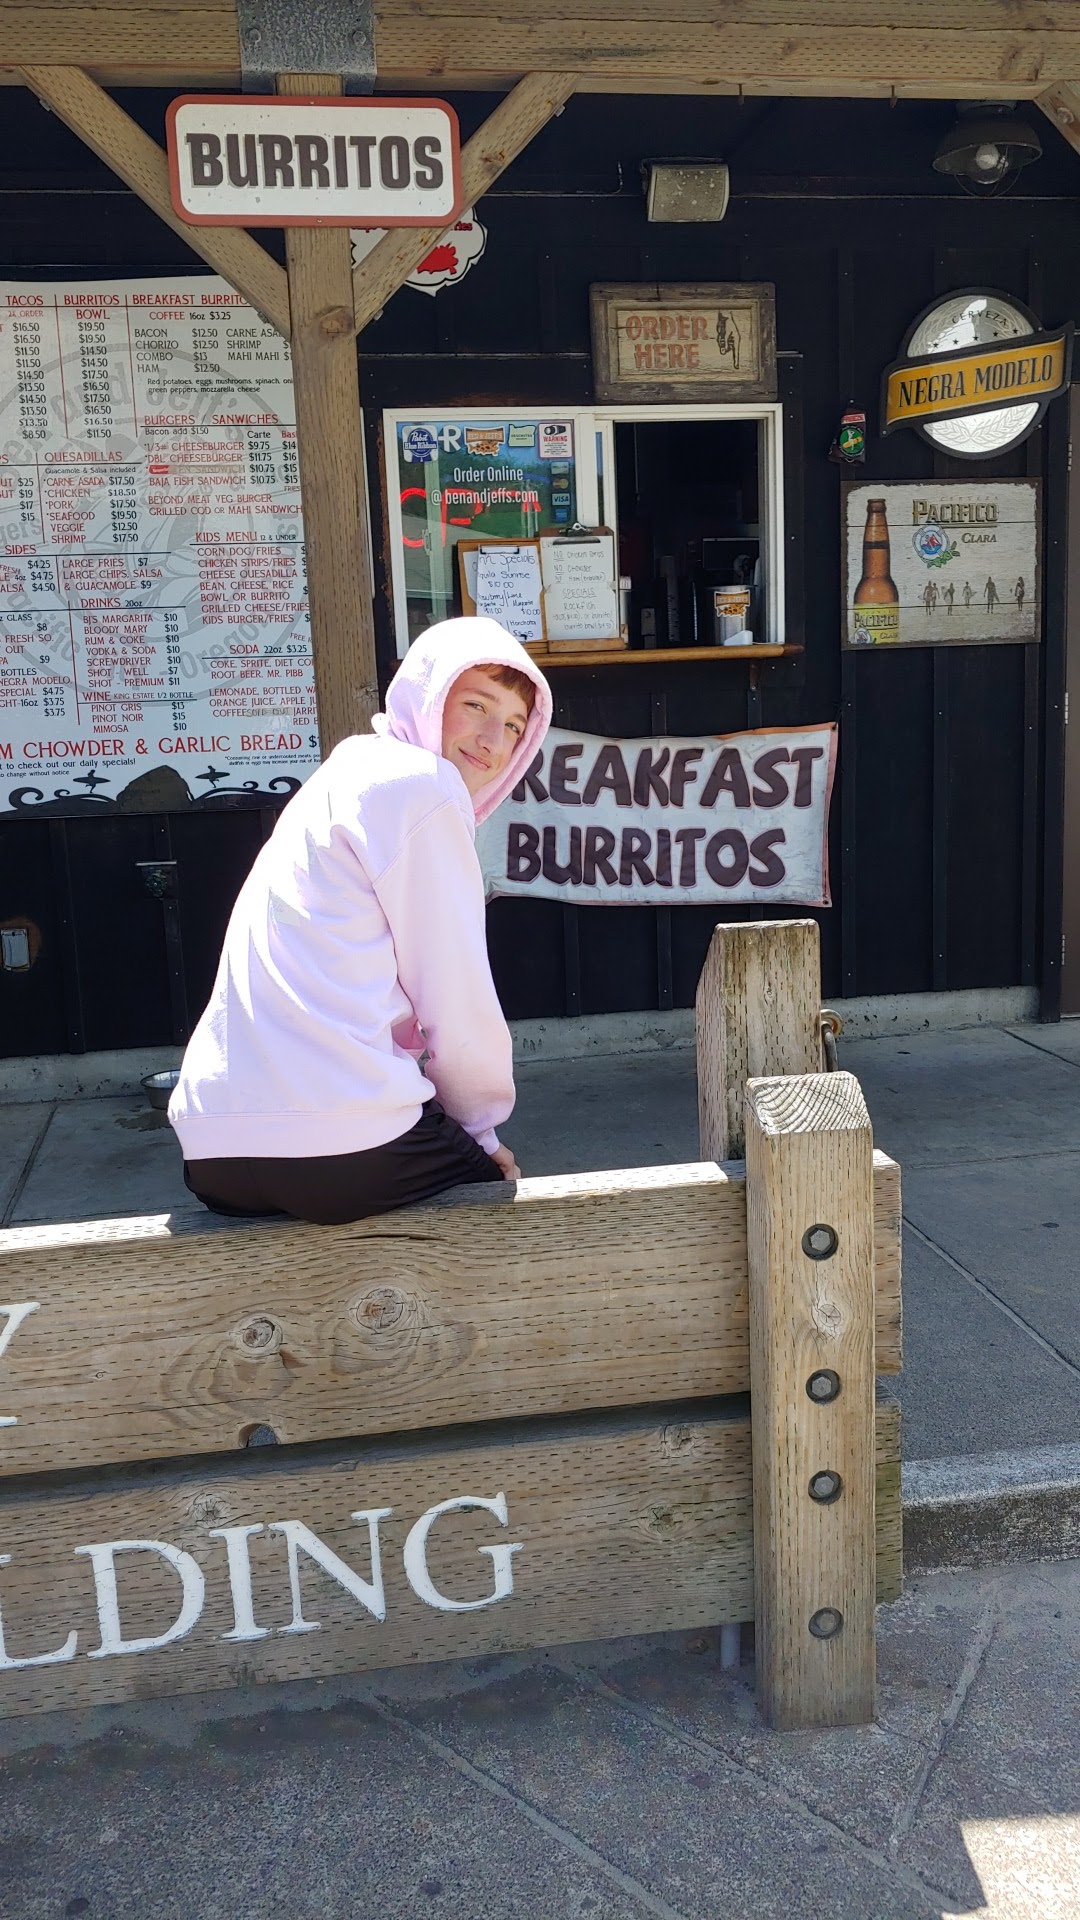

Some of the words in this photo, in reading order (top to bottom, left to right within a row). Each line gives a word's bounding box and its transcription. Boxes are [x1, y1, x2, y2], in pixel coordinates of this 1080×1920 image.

[186, 133, 443, 189] BURRITOS
[6, 295, 44, 305] TACOS
[64, 295, 120, 305] BURRITOS
[132, 294, 195, 305] BREAKFAST
[201, 294, 249, 305] BURRITO
[76, 309, 110, 319] BOWL
[150, 311, 185, 320] COFFEE
[952, 309, 1007, 327] CERVEZA
[226, 328, 257, 337] CARNE
[626, 315, 709, 340] ORDER
[134, 328, 168, 338] BACON
[135, 340, 179, 350] CHORIZO
[226, 340, 261, 349] SHRIMP
[136, 352, 173, 361] COMBO
[228, 352, 252, 361] MAHI
[255, 352, 280, 361] MAHI
[634, 343, 700, 369] HERE
[137, 364, 160, 373] HAM
[898, 370, 966, 408] NEGRA
[973, 354, 1053, 394] MODELO
[200, 385, 235, 393] mozzarella
[237, 385, 261, 393] cheese
[144, 415, 196, 425] BURGERS
[212, 414, 279, 424] SANWICHES
[145, 427, 170, 435] Bacon
[173, 427, 188, 435] add
[247, 430, 271, 439] Carte
[171, 442, 245, 451] CHEESEBURGER
[44, 452, 123, 462] QUESADILLAS
[147, 454, 166, 463] DBL
[169, 453, 243, 463] CHEESEBURGER
[453, 466, 485, 483] Order
[487, 466, 524, 482] Online
[18, 478, 34, 487] $25
[47, 477, 75, 486] CARNE
[79, 477, 105, 486] ASADA
[150, 477, 170, 488] BAJA
[174, 477, 194, 486] FISH
[197, 476, 246, 485] SANDWICH
[47, 489, 91, 498] CHICKEN
[431, 490, 442, 505] @
[445, 488, 539, 507] benandjeffs.com
[148, 495, 184, 505] BEYOND
[188, 495, 210, 503] MEAT
[215, 494, 234, 503] VEG
[237, 494, 273, 502] BURGER
[48, 501, 74, 509] PORK
[149, 506, 186, 516] GRILLED
[228, 506, 251, 514] MAHI
[255, 505, 302, 514] SANDWICH
[49, 512, 95, 521] SEAFOOD
[51, 523, 85, 532] VEGGIE
[51, 535, 87, 544] SHRIMP
[195, 532, 221, 542] KIDS
[226, 531, 257, 542] MENU
[5, 544, 37, 555] SIDES
[197, 548, 225, 557] CORN
[229, 547, 281, 556] DOG/FRIES
[62, 559, 94, 568] LARGE
[98, 558, 124, 567] FRIES
[198, 559, 238, 568] CHICKEN
[241, 558, 296, 567] STRIPS/FRIES
[63, 571, 95, 580] LARGE
[133, 568, 163, 578] SALSA
[199, 571, 236, 579] CHEESE
[239, 569, 298, 578] QUESADILLA
[76, 581, 136, 590] GUACAMOLE
[140, 580, 152, 589] $9
[201, 593, 228, 602] BOWL
[251, 592, 290, 600] BURRITO
[80, 598, 121, 608] DRINKS
[201, 604, 240, 613] GRILLED
[102, 614, 153, 623] MARGARITA
[164, 613, 178, 622] $10
[202, 616, 224, 624] KIDS
[227, 614, 294, 624] BURGER/FRIES
[84, 625, 120, 634] BLOODY
[124, 625, 148, 634] MARY
[85, 636, 105, 645] RUM
[119, 635, 145, 644] COKE
[86, 647, 117, 656] VODKA
[132, 646, 157, 655] SODA
[229, 644, 260, 655] SODA
[86, 657, 151, 666] SCREWDRIVER
[87, 669, 112, 677] SHOT
[124, 668, 149, 676] WELL
[286, 669, 303, 677] PIBB
[88, 680, 112, 688] SHOT
[124, 678, 164, 687] PREMIUM
[169, 678, 180, 686] $11
[263, 686, 302, 695] BOTTLED
[83, 691, 111, 702] WINE
[91, 703, 117, 712] PINOT
[120, 703, 142, 711] GRIS
[92, 714, 117, 723] PINOT
[122, 714, 144, 722] NOIR
[93, 725, 129, 733] MIMOSA
[23, 739, 125, 759] CHOWDER
[135, 739, 149, 754] &
[158, 735, 231, 754] GARLIC
[240, 733, 302, 751] BREAD
[18, 760, 43, 769] check
[80, 759, 98, 769] daily
[102, 758, 136, 767] specials!
[510, 744, 824, 808] REAKFAST
[506, 823, 786, 888] BURRITOS
